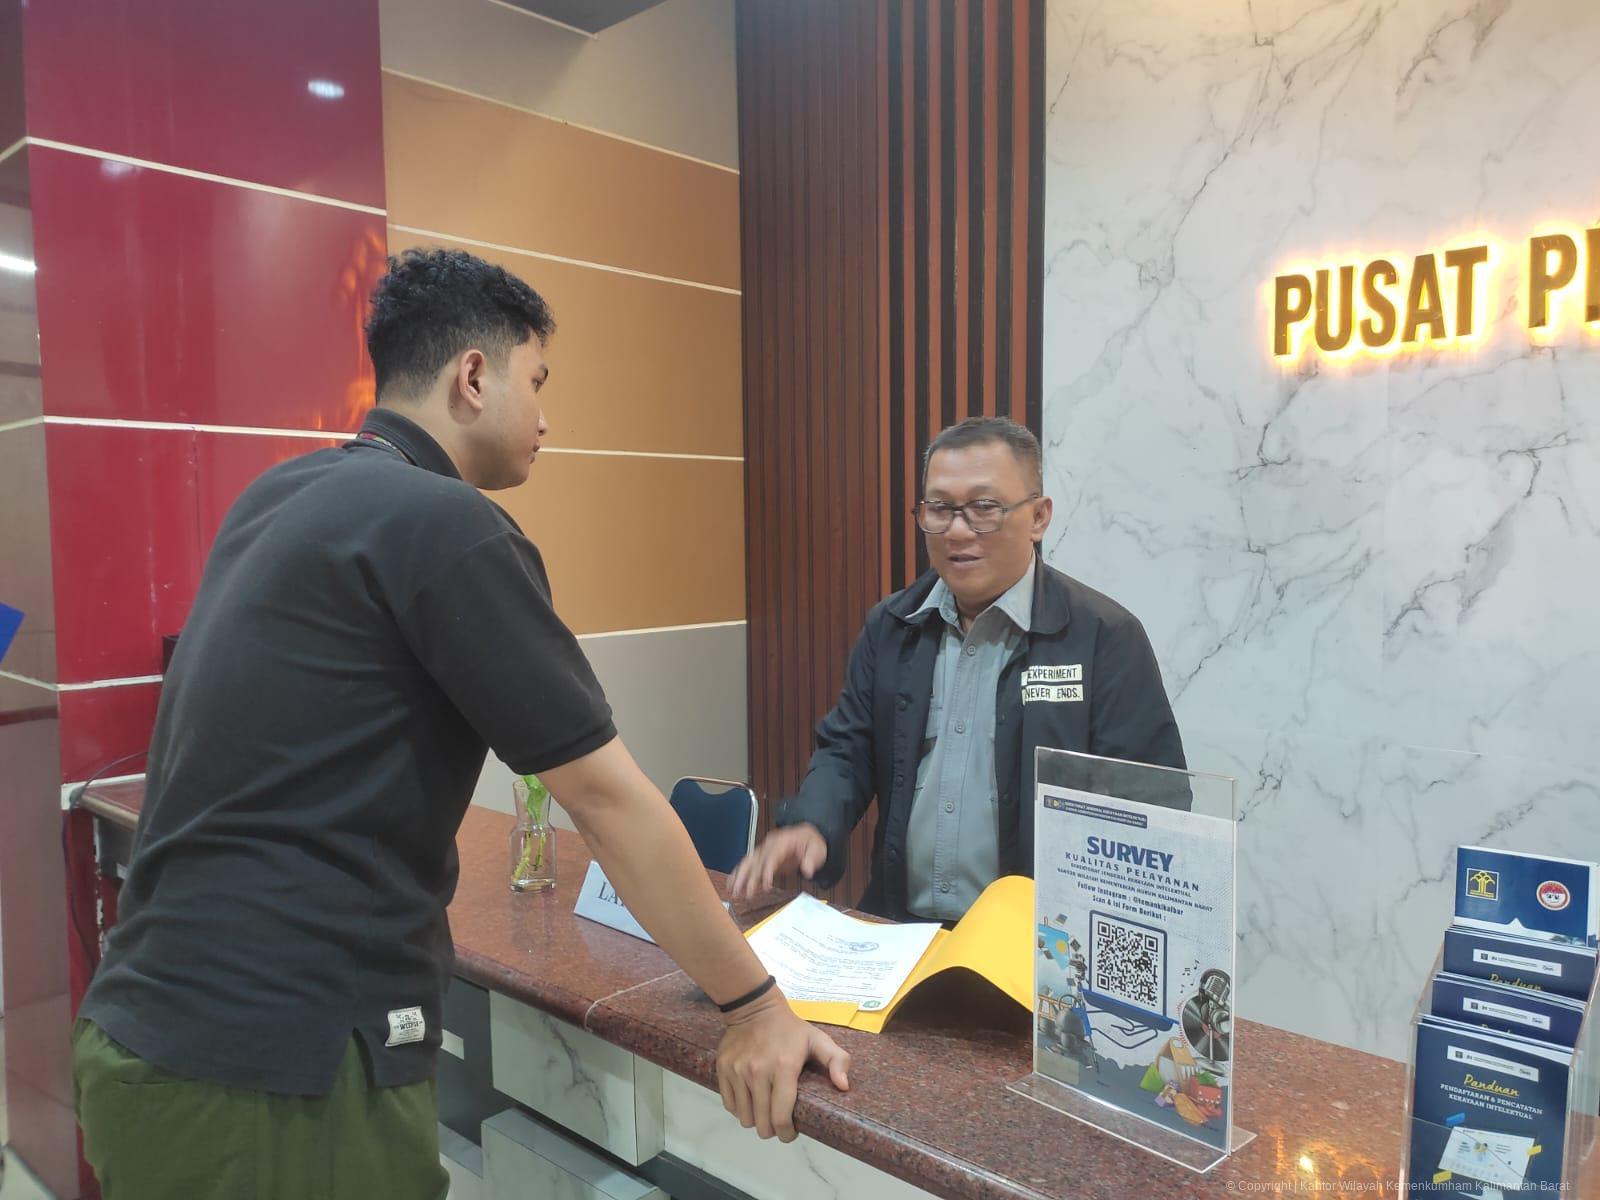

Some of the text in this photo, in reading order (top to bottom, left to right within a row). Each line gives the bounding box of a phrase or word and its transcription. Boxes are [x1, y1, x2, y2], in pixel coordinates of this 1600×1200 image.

[1274, 245, 1487, 356] PUSAT
[1027, 668, 1077, 679] EXPERIMENT
[1025, 687, 1081, 699] NEVER ENDS.
[1087, 836, 1174, 872] SURVEY
[1065, 852, 1199, 891] KUALITAS PELAYANAN
[597, 881, 625, 907] LA
[1078, 881, 1096, 891] Follow
[1098, 887, 1127, 899] Instagram
[1158, 893, 1192, 906] KALIMANTAN
[1093, 895, 1105, 903] Scan
[1122, 903, 1137, 912] Form
[1140, 908, 1162, 919] Berikut
[1463, 1074, 1519, 1096] Panduan
[1440, 1083, 1490, 1101] PENDAFTARAN
[1497, 1098, 1543, 1115] PENCATATAN
[1449, 1093, 1533, 1120] KEKAYAAN INTELEKTUAL
